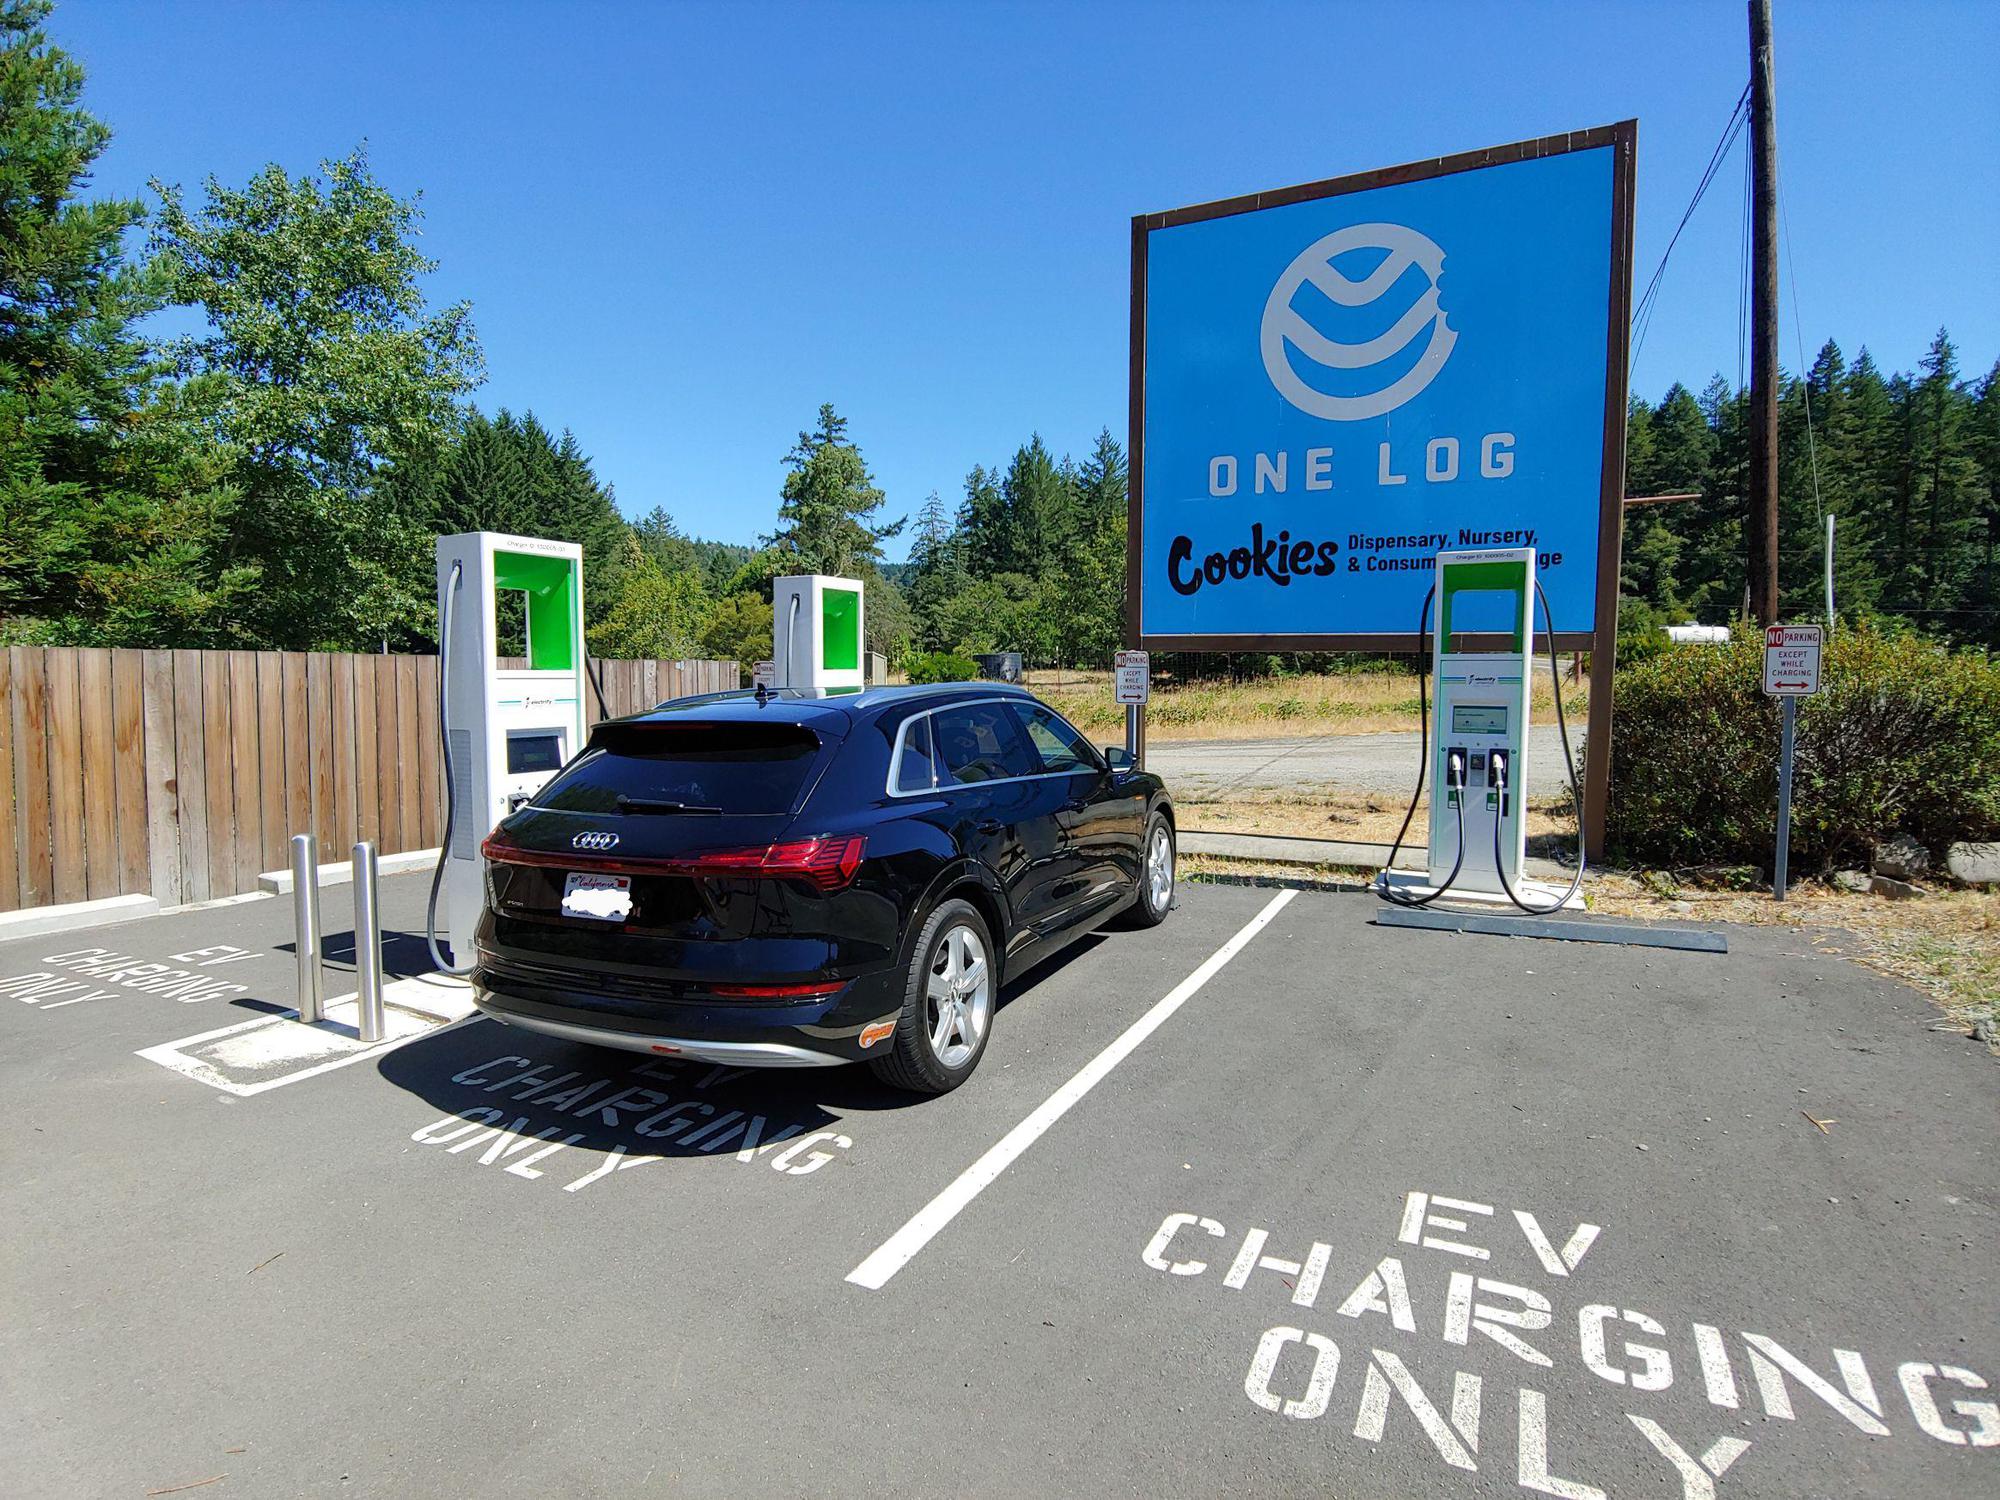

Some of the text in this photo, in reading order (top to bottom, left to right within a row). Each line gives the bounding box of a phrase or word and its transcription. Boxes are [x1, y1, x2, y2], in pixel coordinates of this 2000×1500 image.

[1209, 432, 1516, 497] ONE LOG
[1347, 528, 1538, 552] Dispensary, Nursery,
[1168, 522, 1339, 596] Cookies
[1347, 556, 1436, 572] & Consum
[1768, 630, 1818, 645] NO PARKING
[1117, 655, 1147, 666] NO PARKING
[1778, 650, 1808, 658] EXCEPT
[1780, 660, 1804, 668] WHILE
[1772, 669, 1812, 677] CHARGING
[578, 876, 615, 889] California
[168, 944, 265, 967] EV
[41, 948, 249, 1004] CHARGING
[451, 1055, 853, 1175] CHARGING
[410, 1106, 664, 1193] ONLY
[1399, 1191, 1601, 1277] EV
[1142, 1212, 2000, 1448] CHARGING
[1244, 1326, 1751, 1500] ONLY
